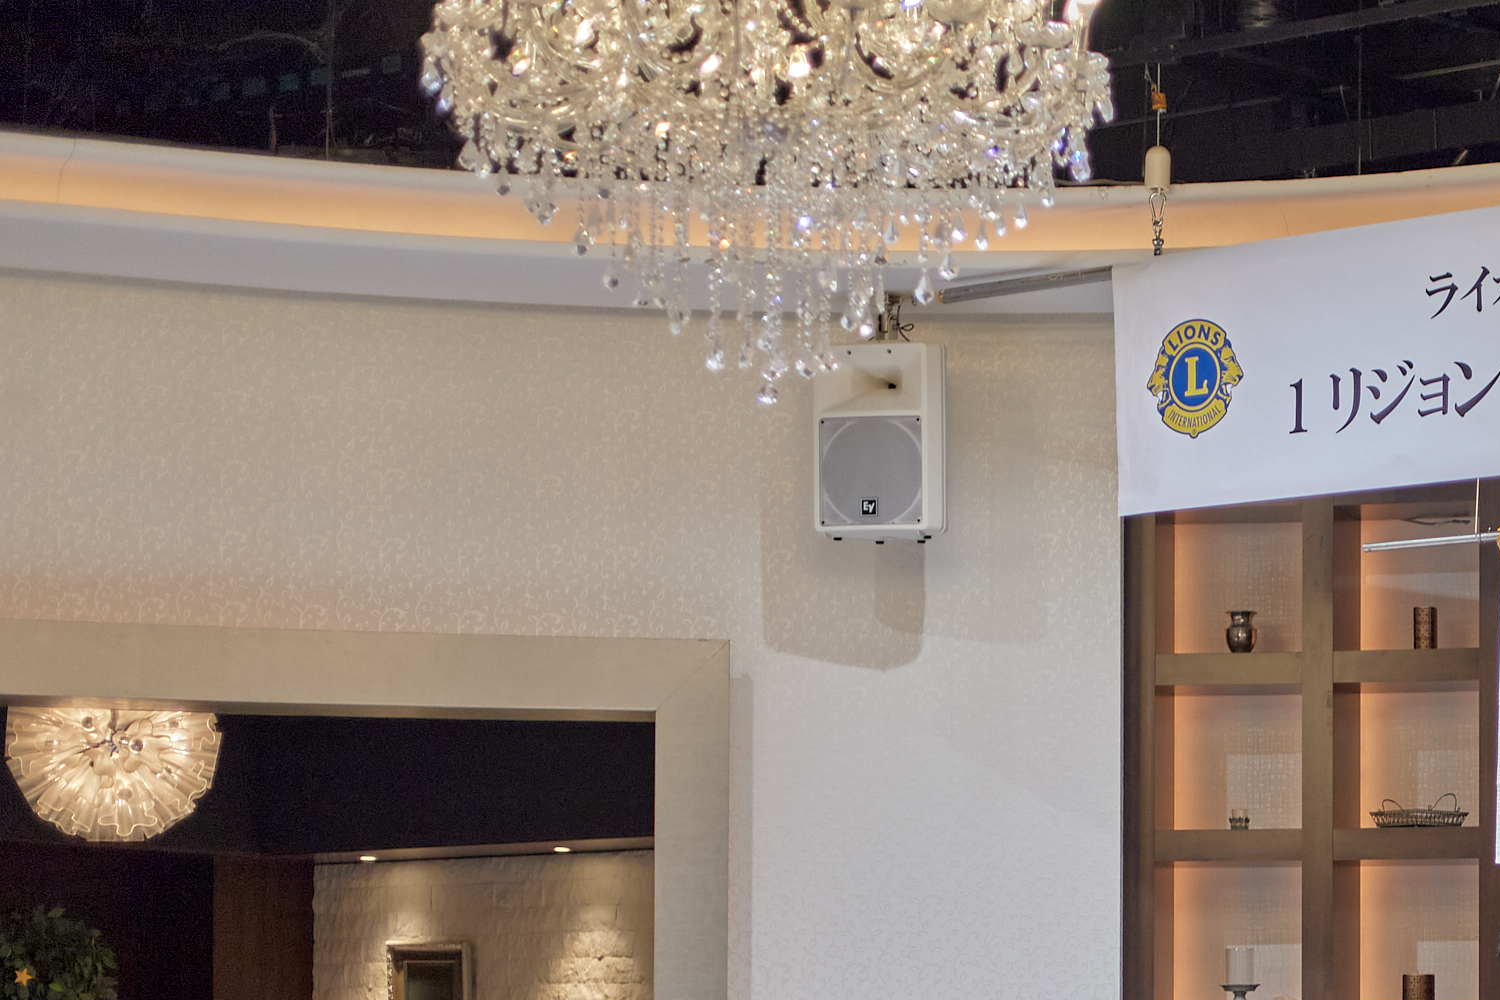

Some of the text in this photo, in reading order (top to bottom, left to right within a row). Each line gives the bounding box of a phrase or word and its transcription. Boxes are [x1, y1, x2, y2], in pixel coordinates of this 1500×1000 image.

[1167, 324, 1222, 352] LIONS
[1184, 356, 1209, 397] L
[1167, 405, 1222, 428] INTERNATIONAL
